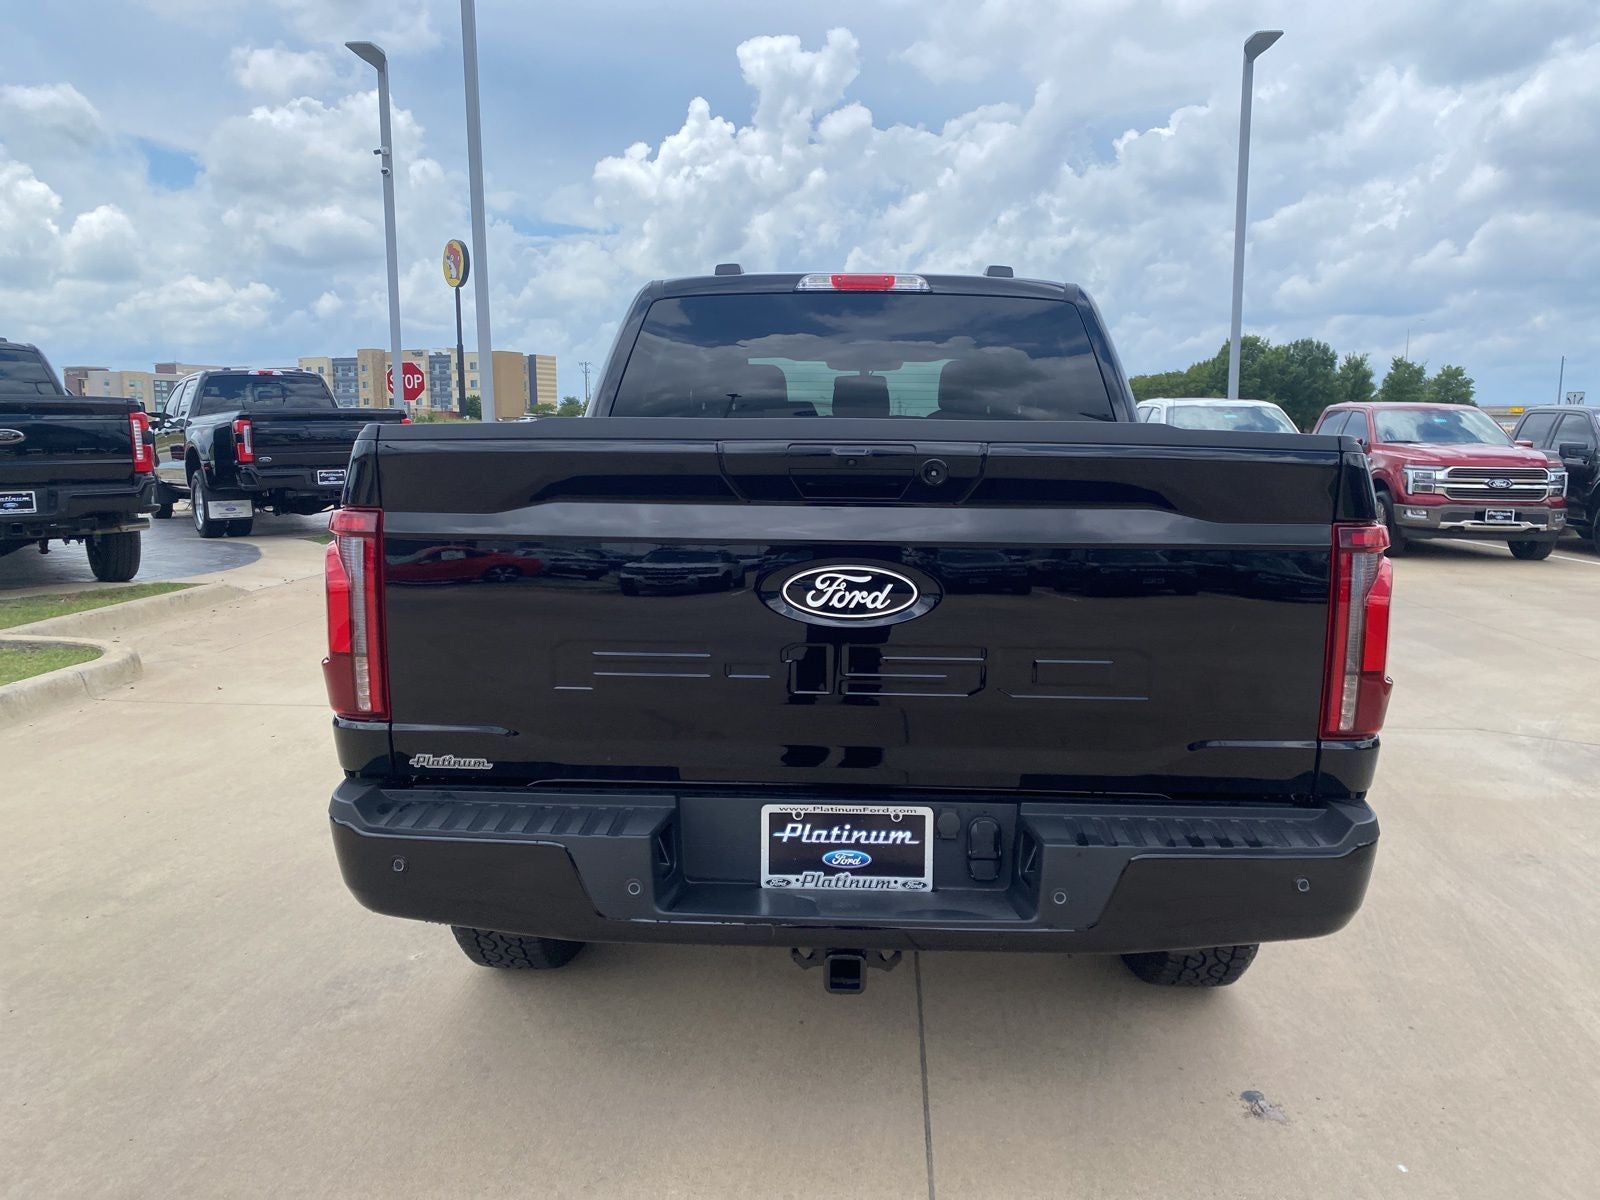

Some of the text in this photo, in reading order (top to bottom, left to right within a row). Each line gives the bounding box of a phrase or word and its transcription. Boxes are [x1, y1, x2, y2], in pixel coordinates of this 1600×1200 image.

[389, 374, 423, 389] OP
[806, 572, 895, 609] Ford
[409, 754, 493, 769] Platinum
[779, 806, 917, 814] www.PlatinumFord.com
[772, 823, 920, 845] Platinum
[831, 853, 862, 866] Ford
[800, 874, 897, 889] Platinum
